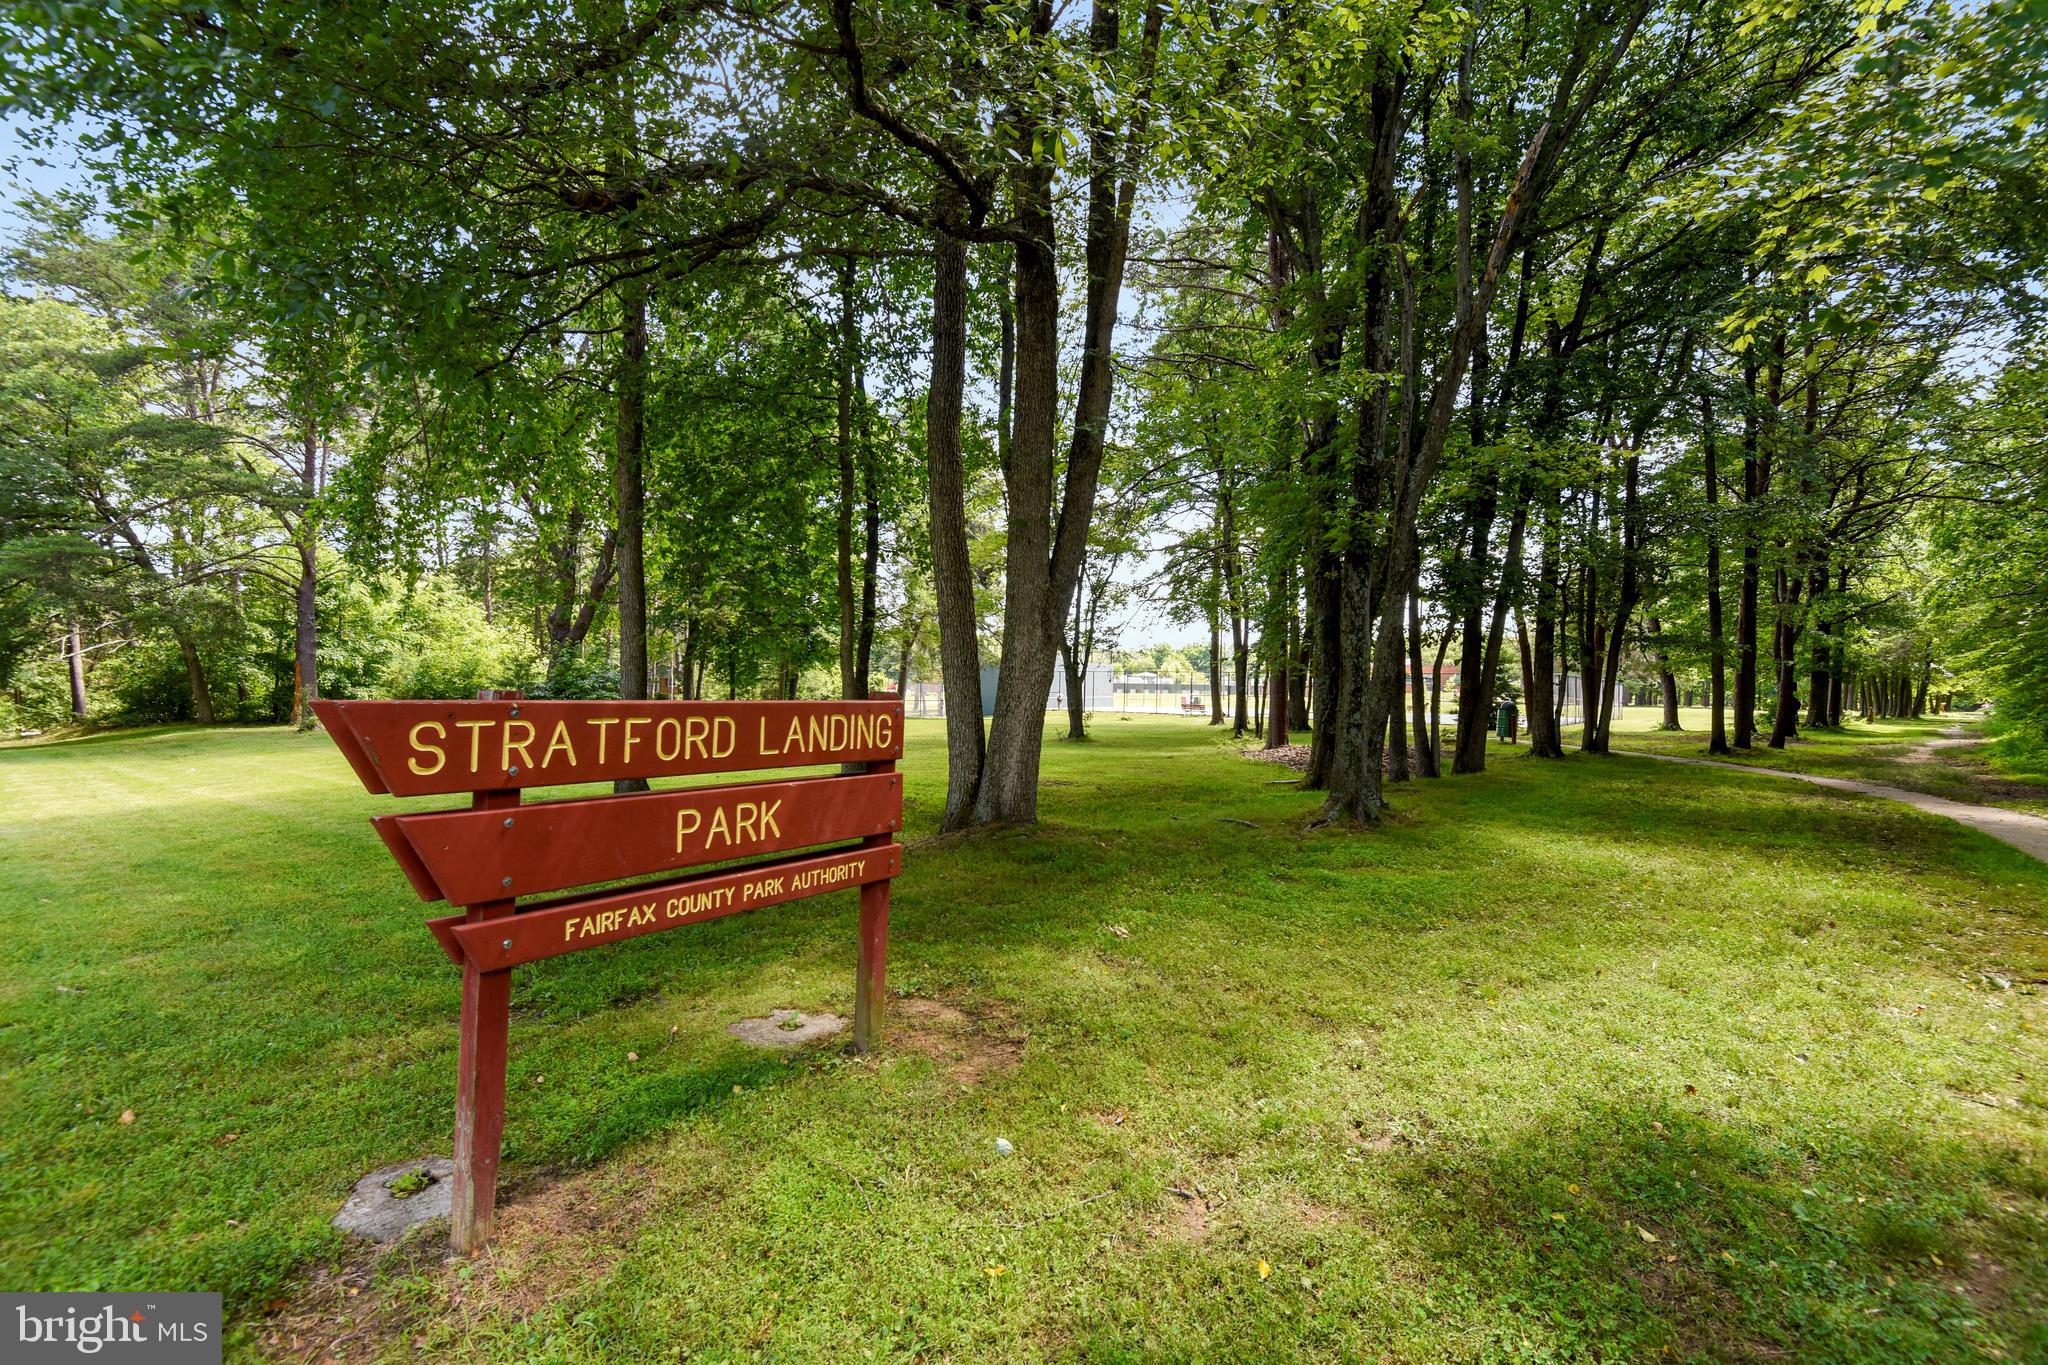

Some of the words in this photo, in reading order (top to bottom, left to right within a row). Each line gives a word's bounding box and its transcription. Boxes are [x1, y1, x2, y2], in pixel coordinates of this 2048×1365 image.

[407, 715, 736, 775] STRATFORD
[759, 713, 893, 756] LANDING
[676, 799, 782, 853] PARK
[564, 902, 656, 941] FAIRFAX
[666, 886, 735, 919] COUNTY
[743, 877, 784, 900] PARK
[792, 860, 867, 892] AUTHORITY
